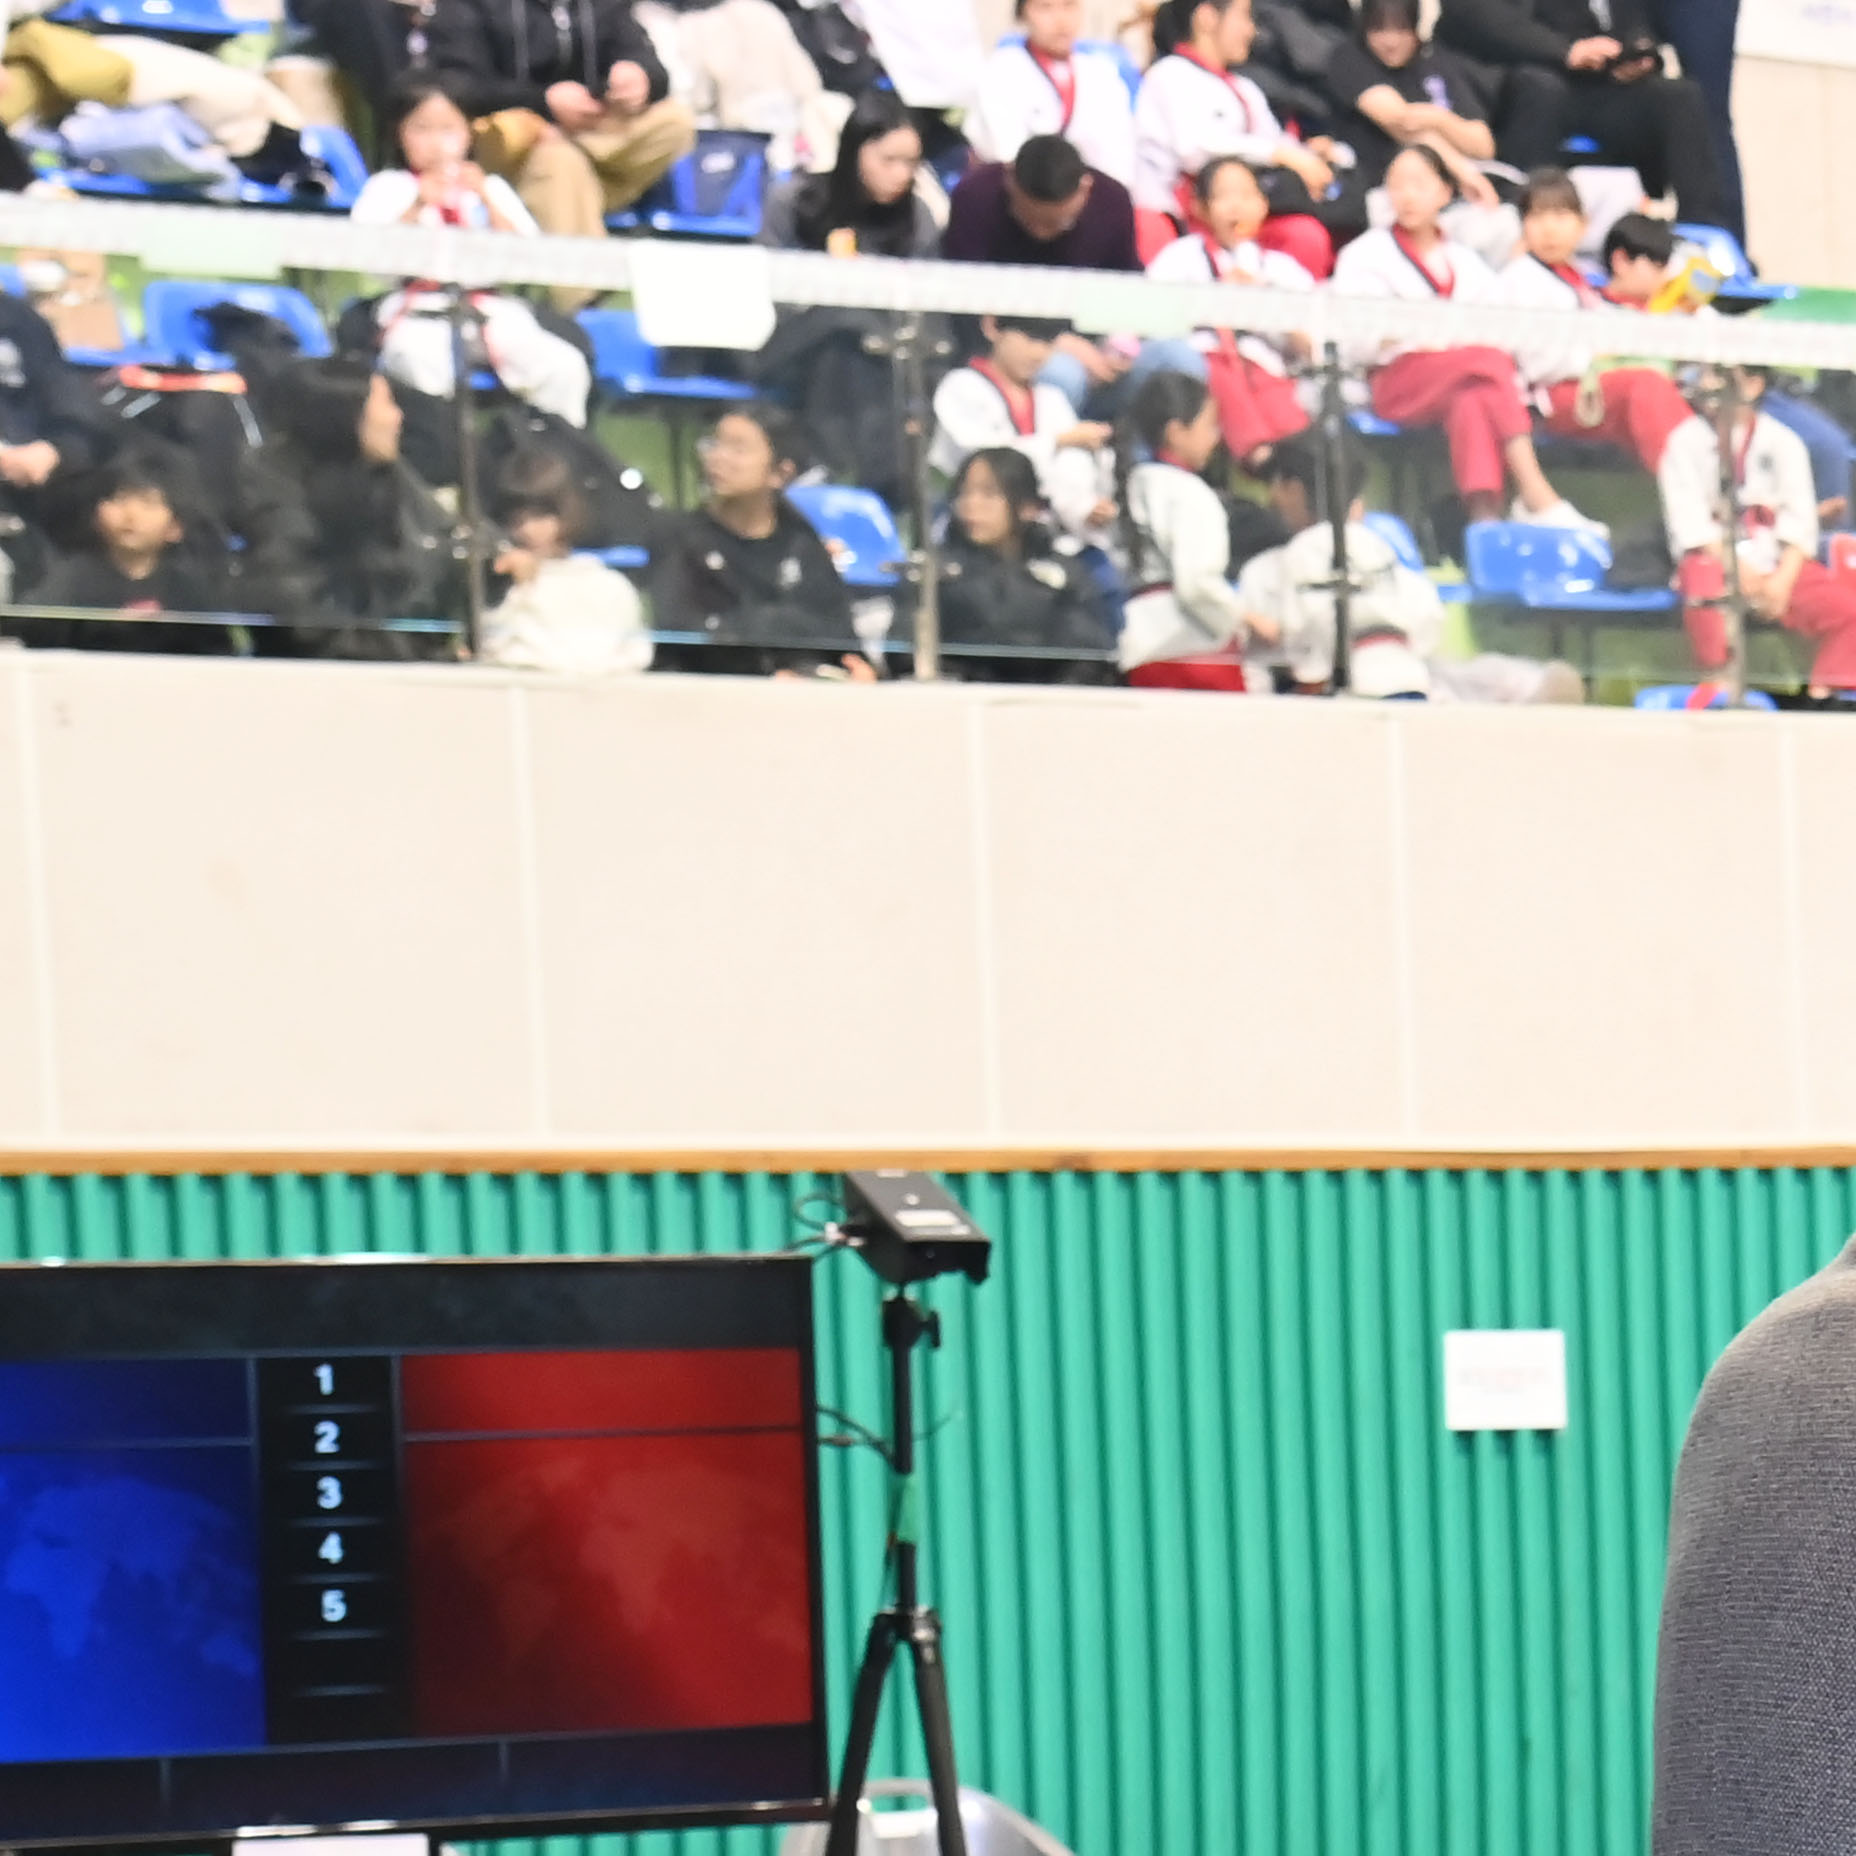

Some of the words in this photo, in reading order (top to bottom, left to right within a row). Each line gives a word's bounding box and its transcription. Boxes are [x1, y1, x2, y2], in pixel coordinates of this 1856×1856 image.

[314, 1364, 335, 1396] 1
[314, 1421, 340, 1454] 2
[317, 1476, 342, 1510] 3
[318, 1532, 343, 1564] 4
[320, 1590, 347, 1621] 5
